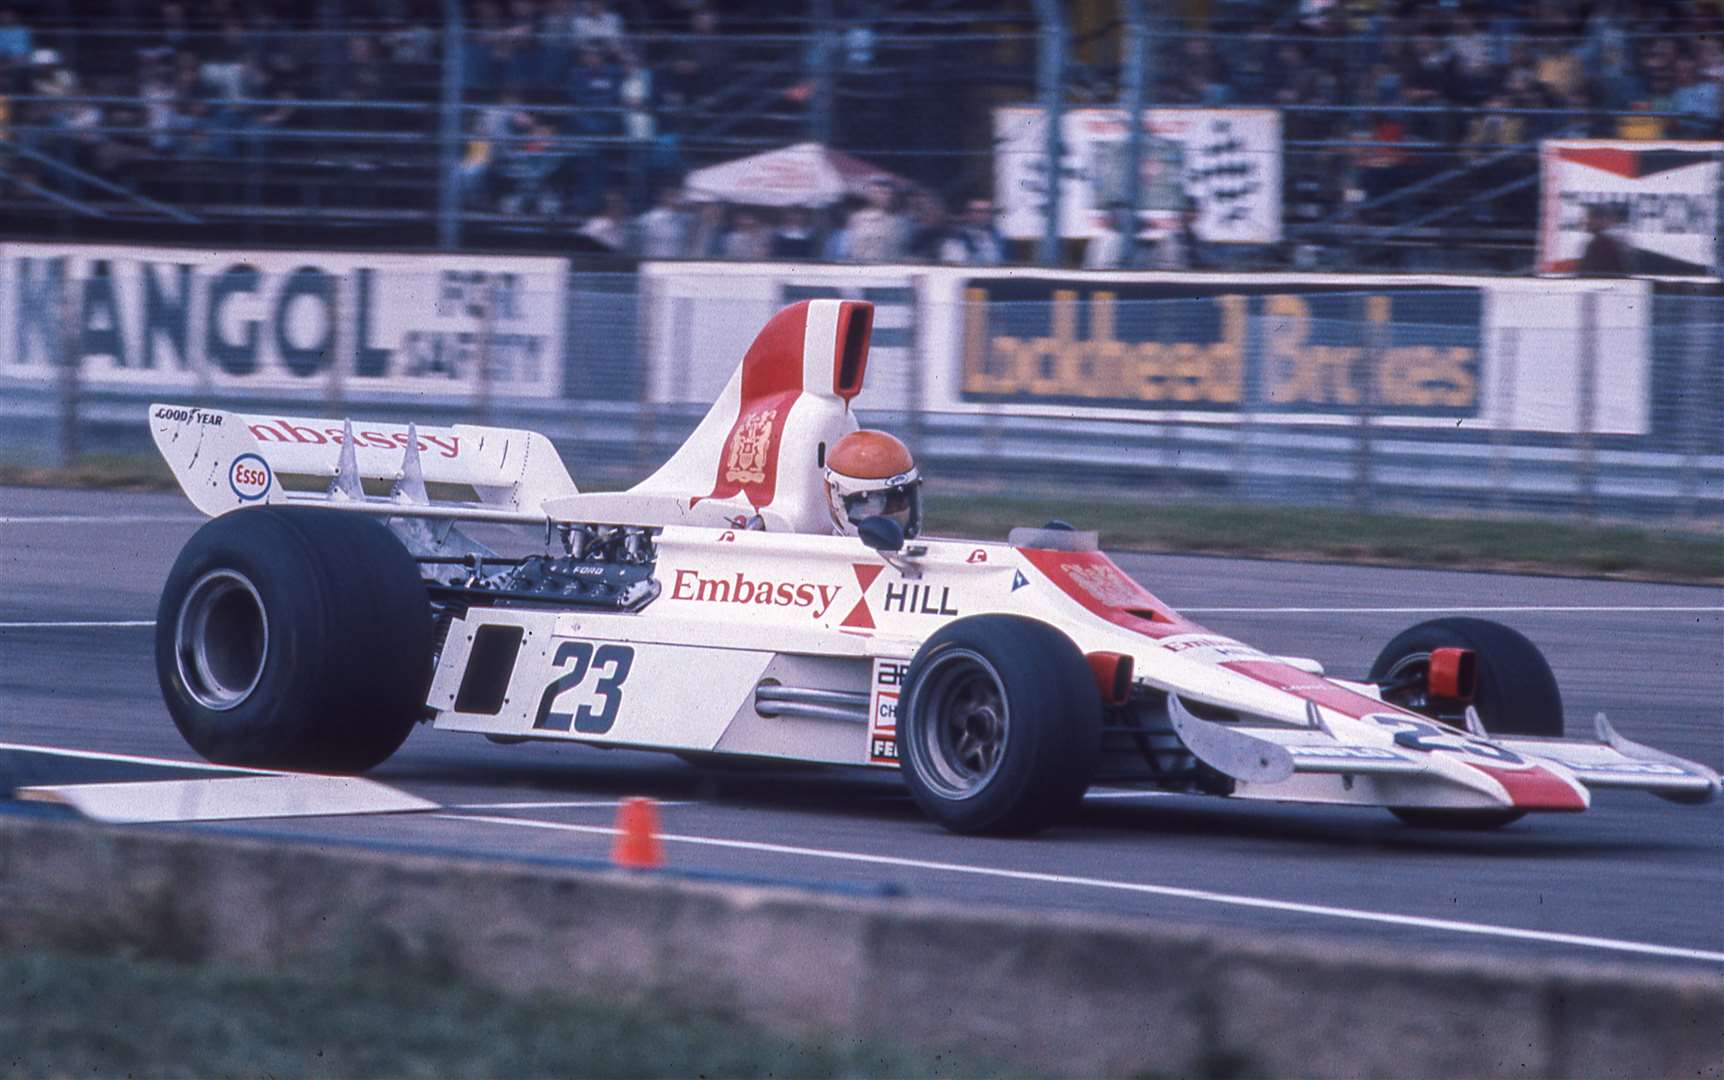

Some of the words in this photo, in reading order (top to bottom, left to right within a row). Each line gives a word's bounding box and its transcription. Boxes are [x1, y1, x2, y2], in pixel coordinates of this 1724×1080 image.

[1559, 191, 1715, 235] CHMPION
[964, 288, 1246, 402] Lockheed
[572, 566, 604, 575] FORD
[670, 568, 843, 619] Embassy
[884, 582, 959, 616] HILL
[532, 641, 635, 735] 23
